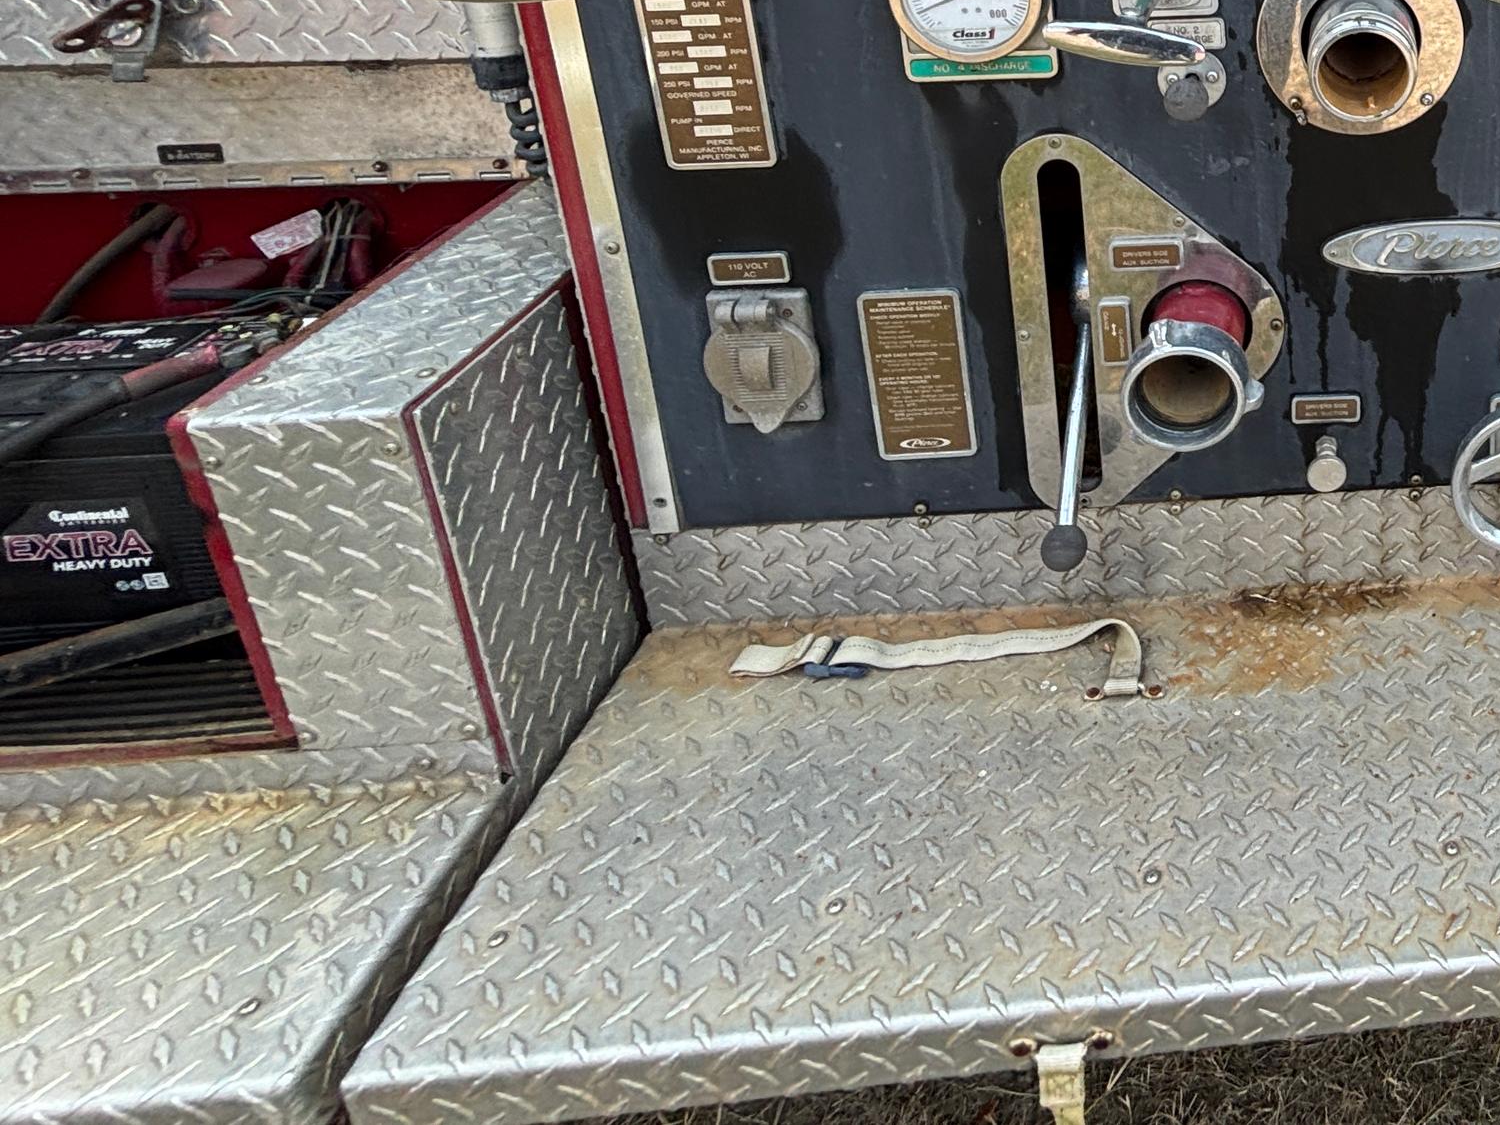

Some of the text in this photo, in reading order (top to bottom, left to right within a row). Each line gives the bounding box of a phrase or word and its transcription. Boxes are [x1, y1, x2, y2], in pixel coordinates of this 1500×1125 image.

[724, 16, 742, 24] RPM
[1193, 26, 1200, 34] 2
[666, 91, 710, 100] GOVERNED
[671, 117, 693, 125] PUMP
[733, 125, 761, 134] DIRECT
[745, 261, 769, 270] VOLT
[48, 507, 130, 523] Continental
[2, 528, 154, 563] EXTRA
[52, 556, 153, 572] HEAVY DUTY
